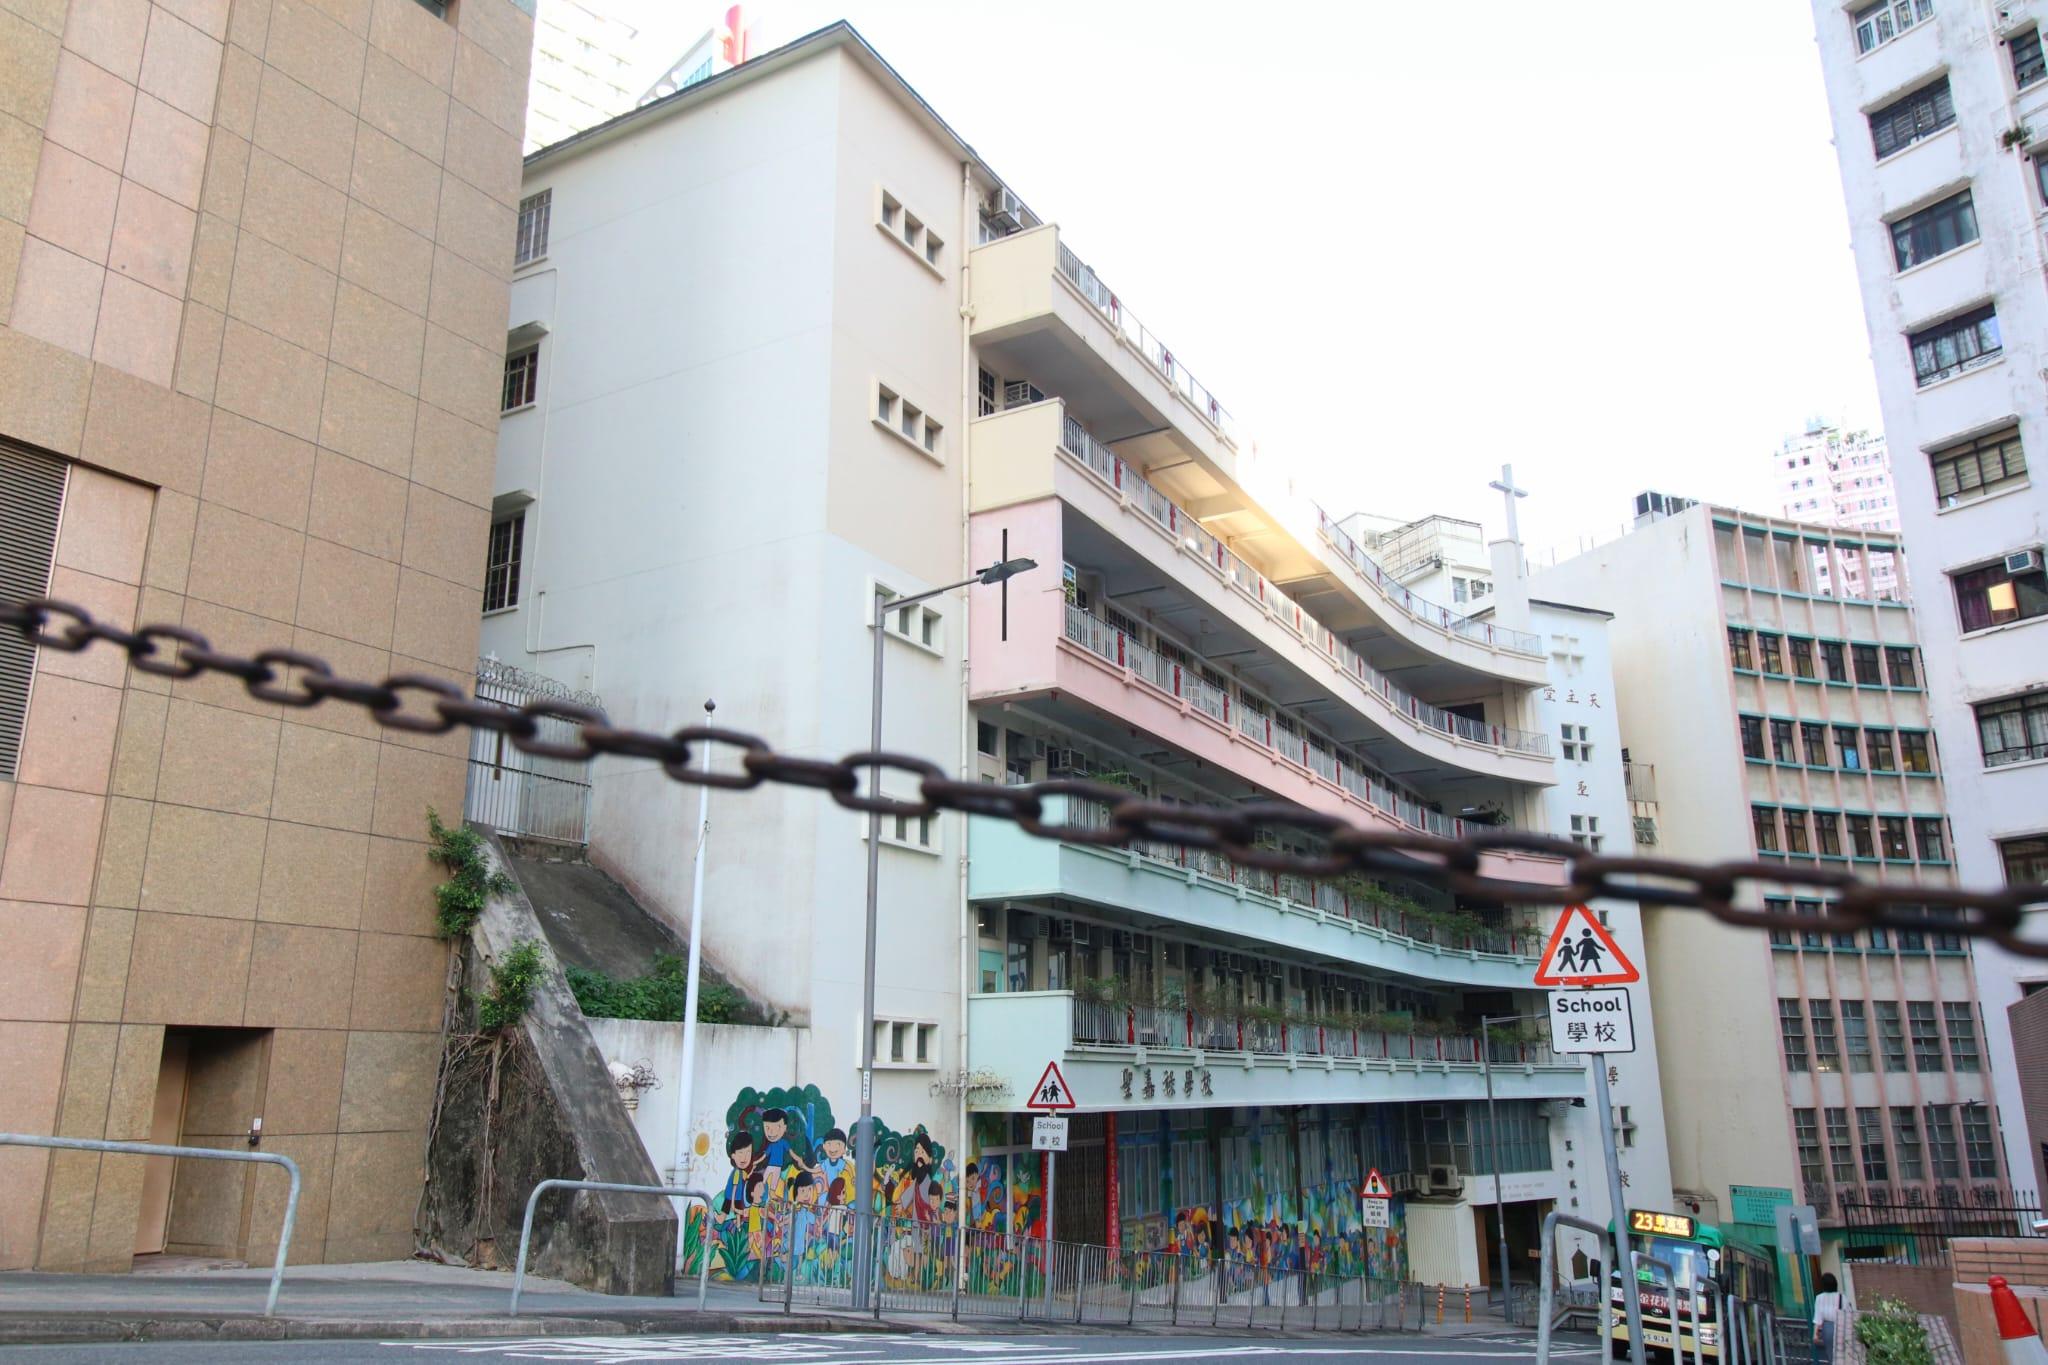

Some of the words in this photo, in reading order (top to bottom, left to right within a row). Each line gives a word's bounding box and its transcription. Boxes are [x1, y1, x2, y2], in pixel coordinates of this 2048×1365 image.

[1556, 996, 1623, 1014] School
[1567, 1021, 1617, 1043] 學校
[1037, 1121, 1064, 1130] School
[1635, 1212, 1653, 1230] 23
